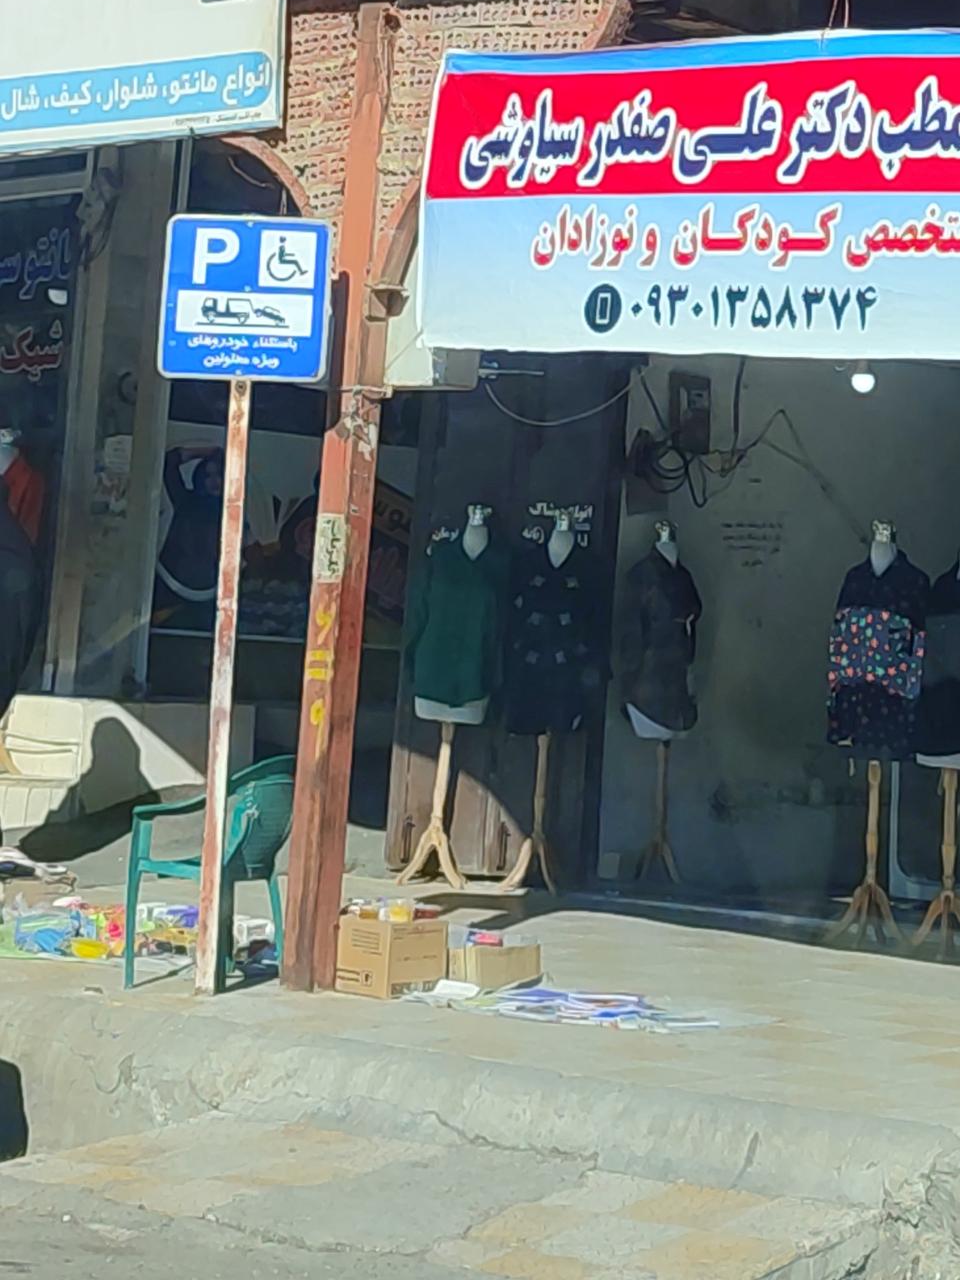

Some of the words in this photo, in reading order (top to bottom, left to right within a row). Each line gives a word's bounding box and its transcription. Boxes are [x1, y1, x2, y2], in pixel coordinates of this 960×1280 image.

[1, 81, 40, 119] شال
[222, 62, 270, 106] انواع
[464, 91, 581, 185] سیاوشی
[580, 94, 673, 182] صفدر
[676, 84, 778, 178] علی
[782, 86, 866, 177] دکتر
[192, 228, 240, 284] P
[533, 207, 636, 266] نوزادان
[639, 229, 658, 267] و
[674, 205, 840, 265] کودکان
